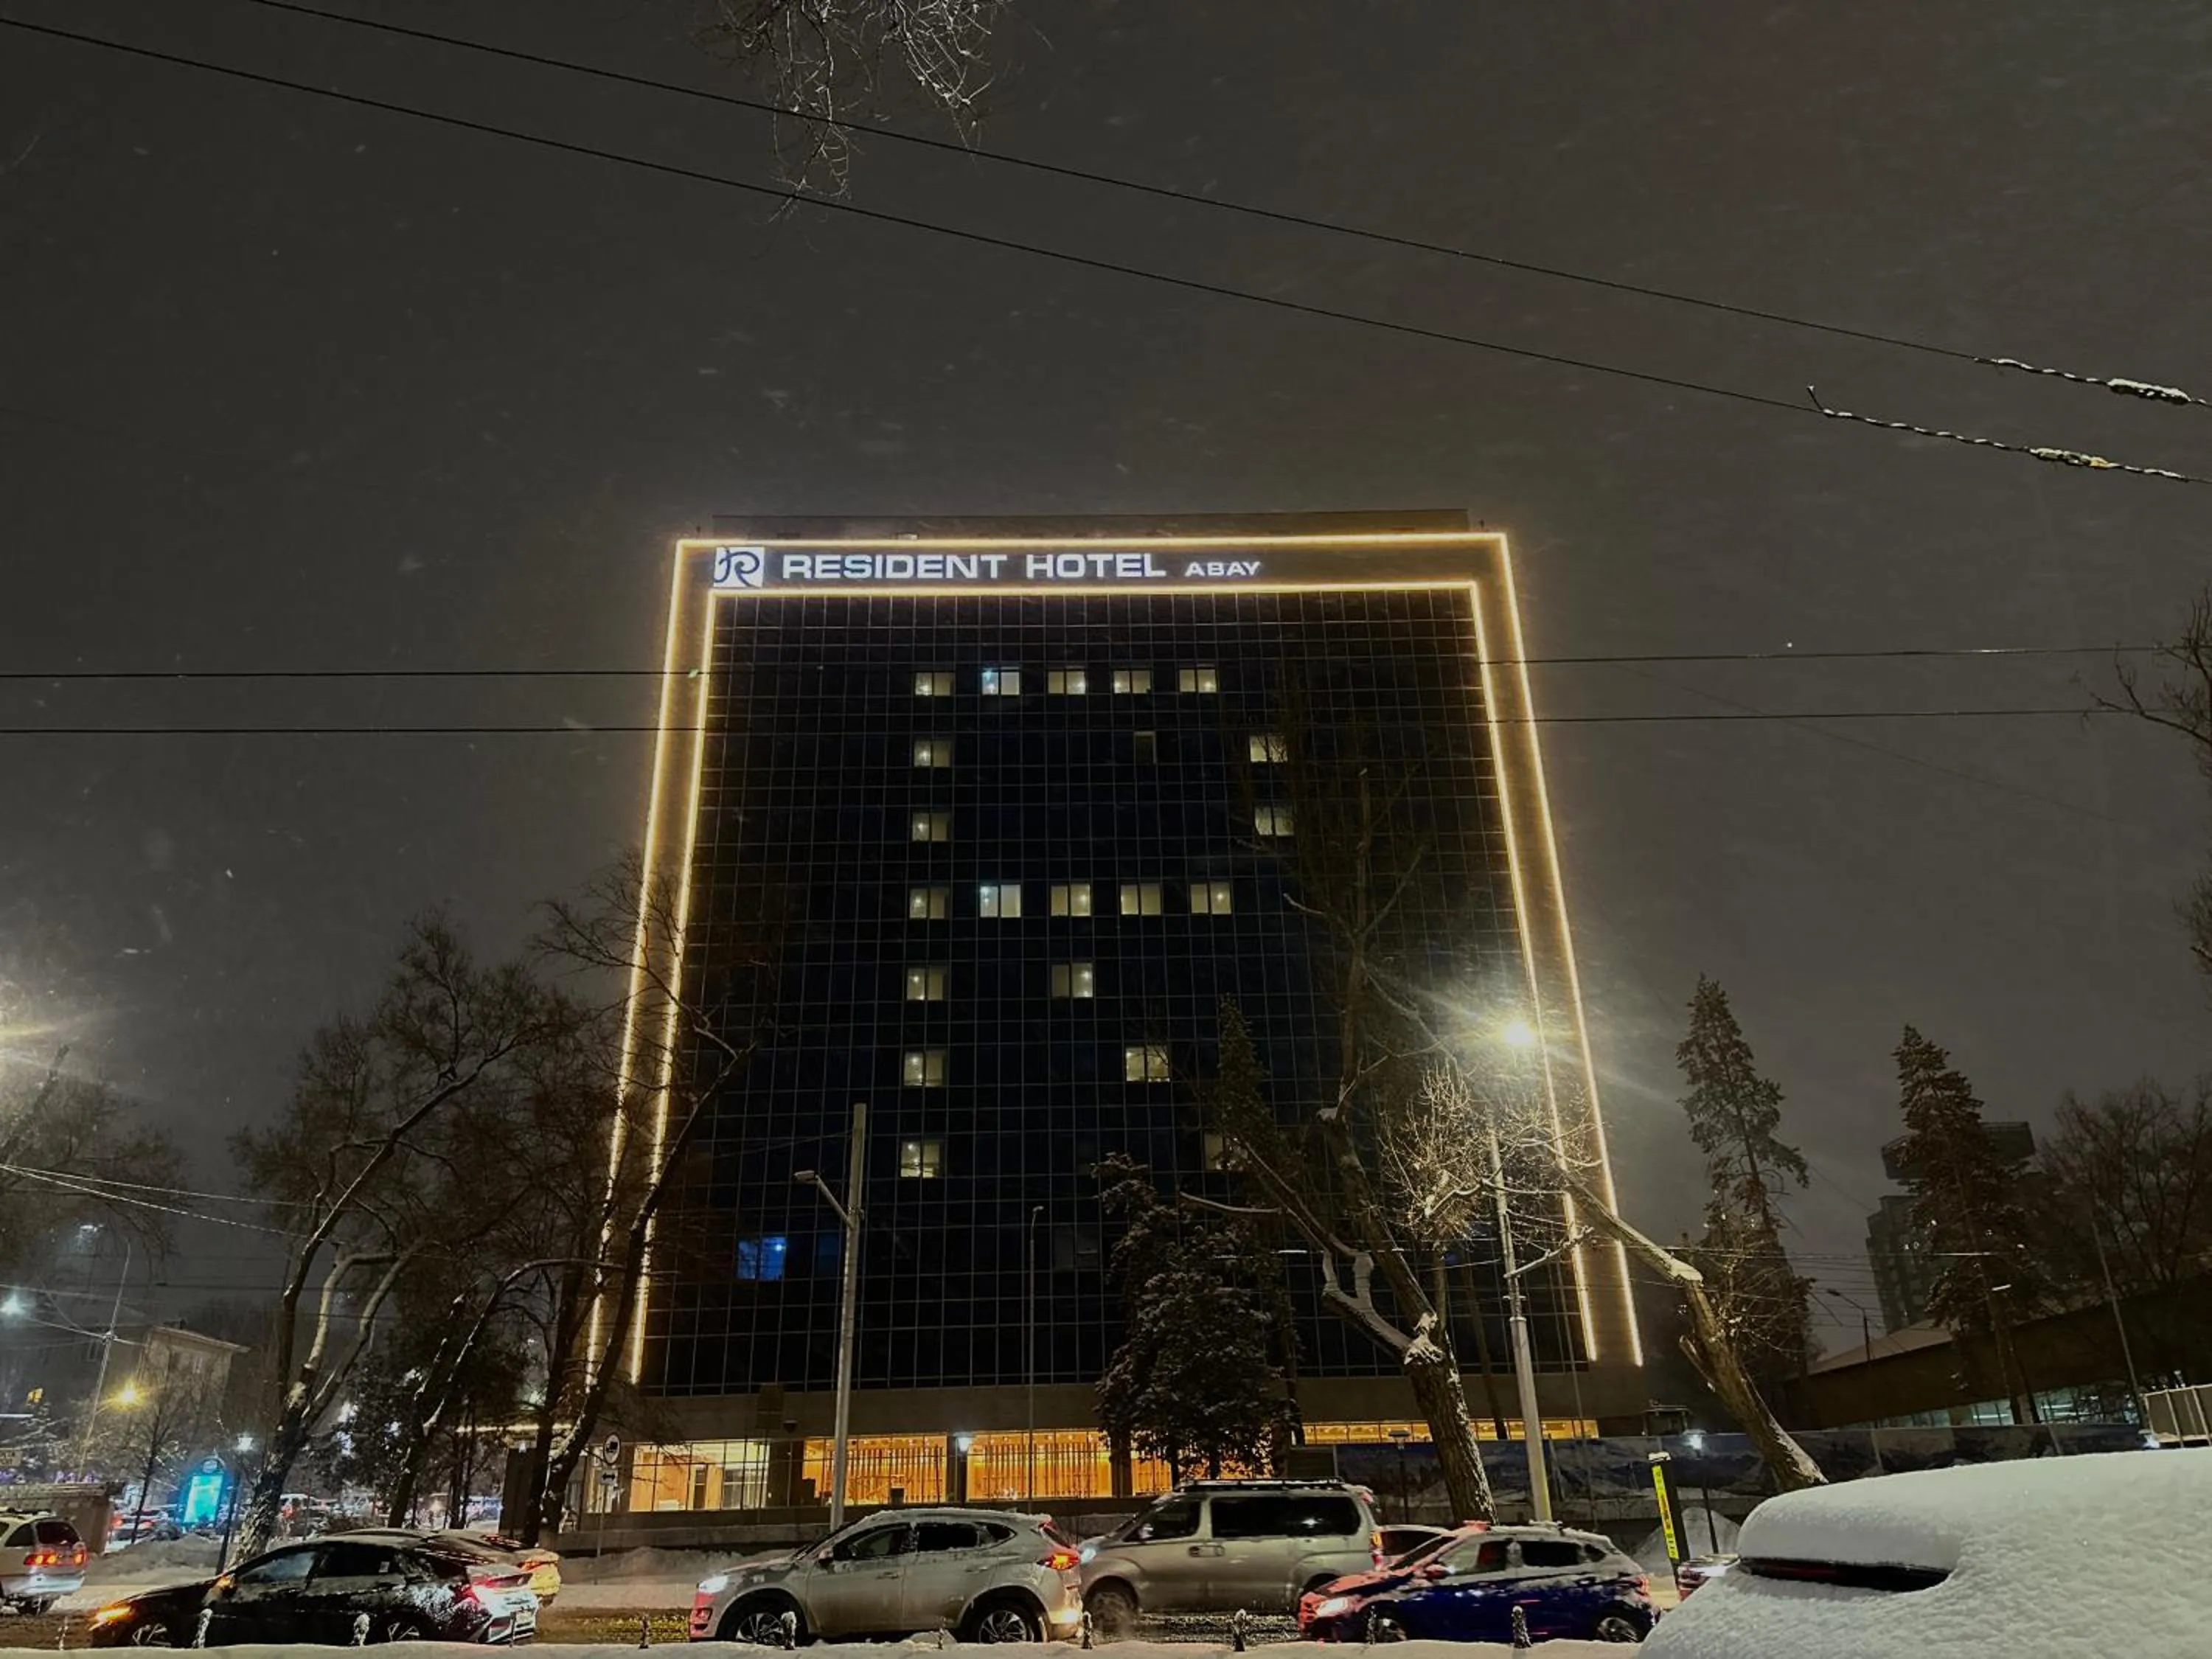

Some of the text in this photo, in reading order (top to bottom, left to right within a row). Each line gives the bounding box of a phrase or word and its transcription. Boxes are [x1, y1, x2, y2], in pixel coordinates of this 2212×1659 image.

[782, 552, 1262, 580] RESIDENT HOTEL ABAY
